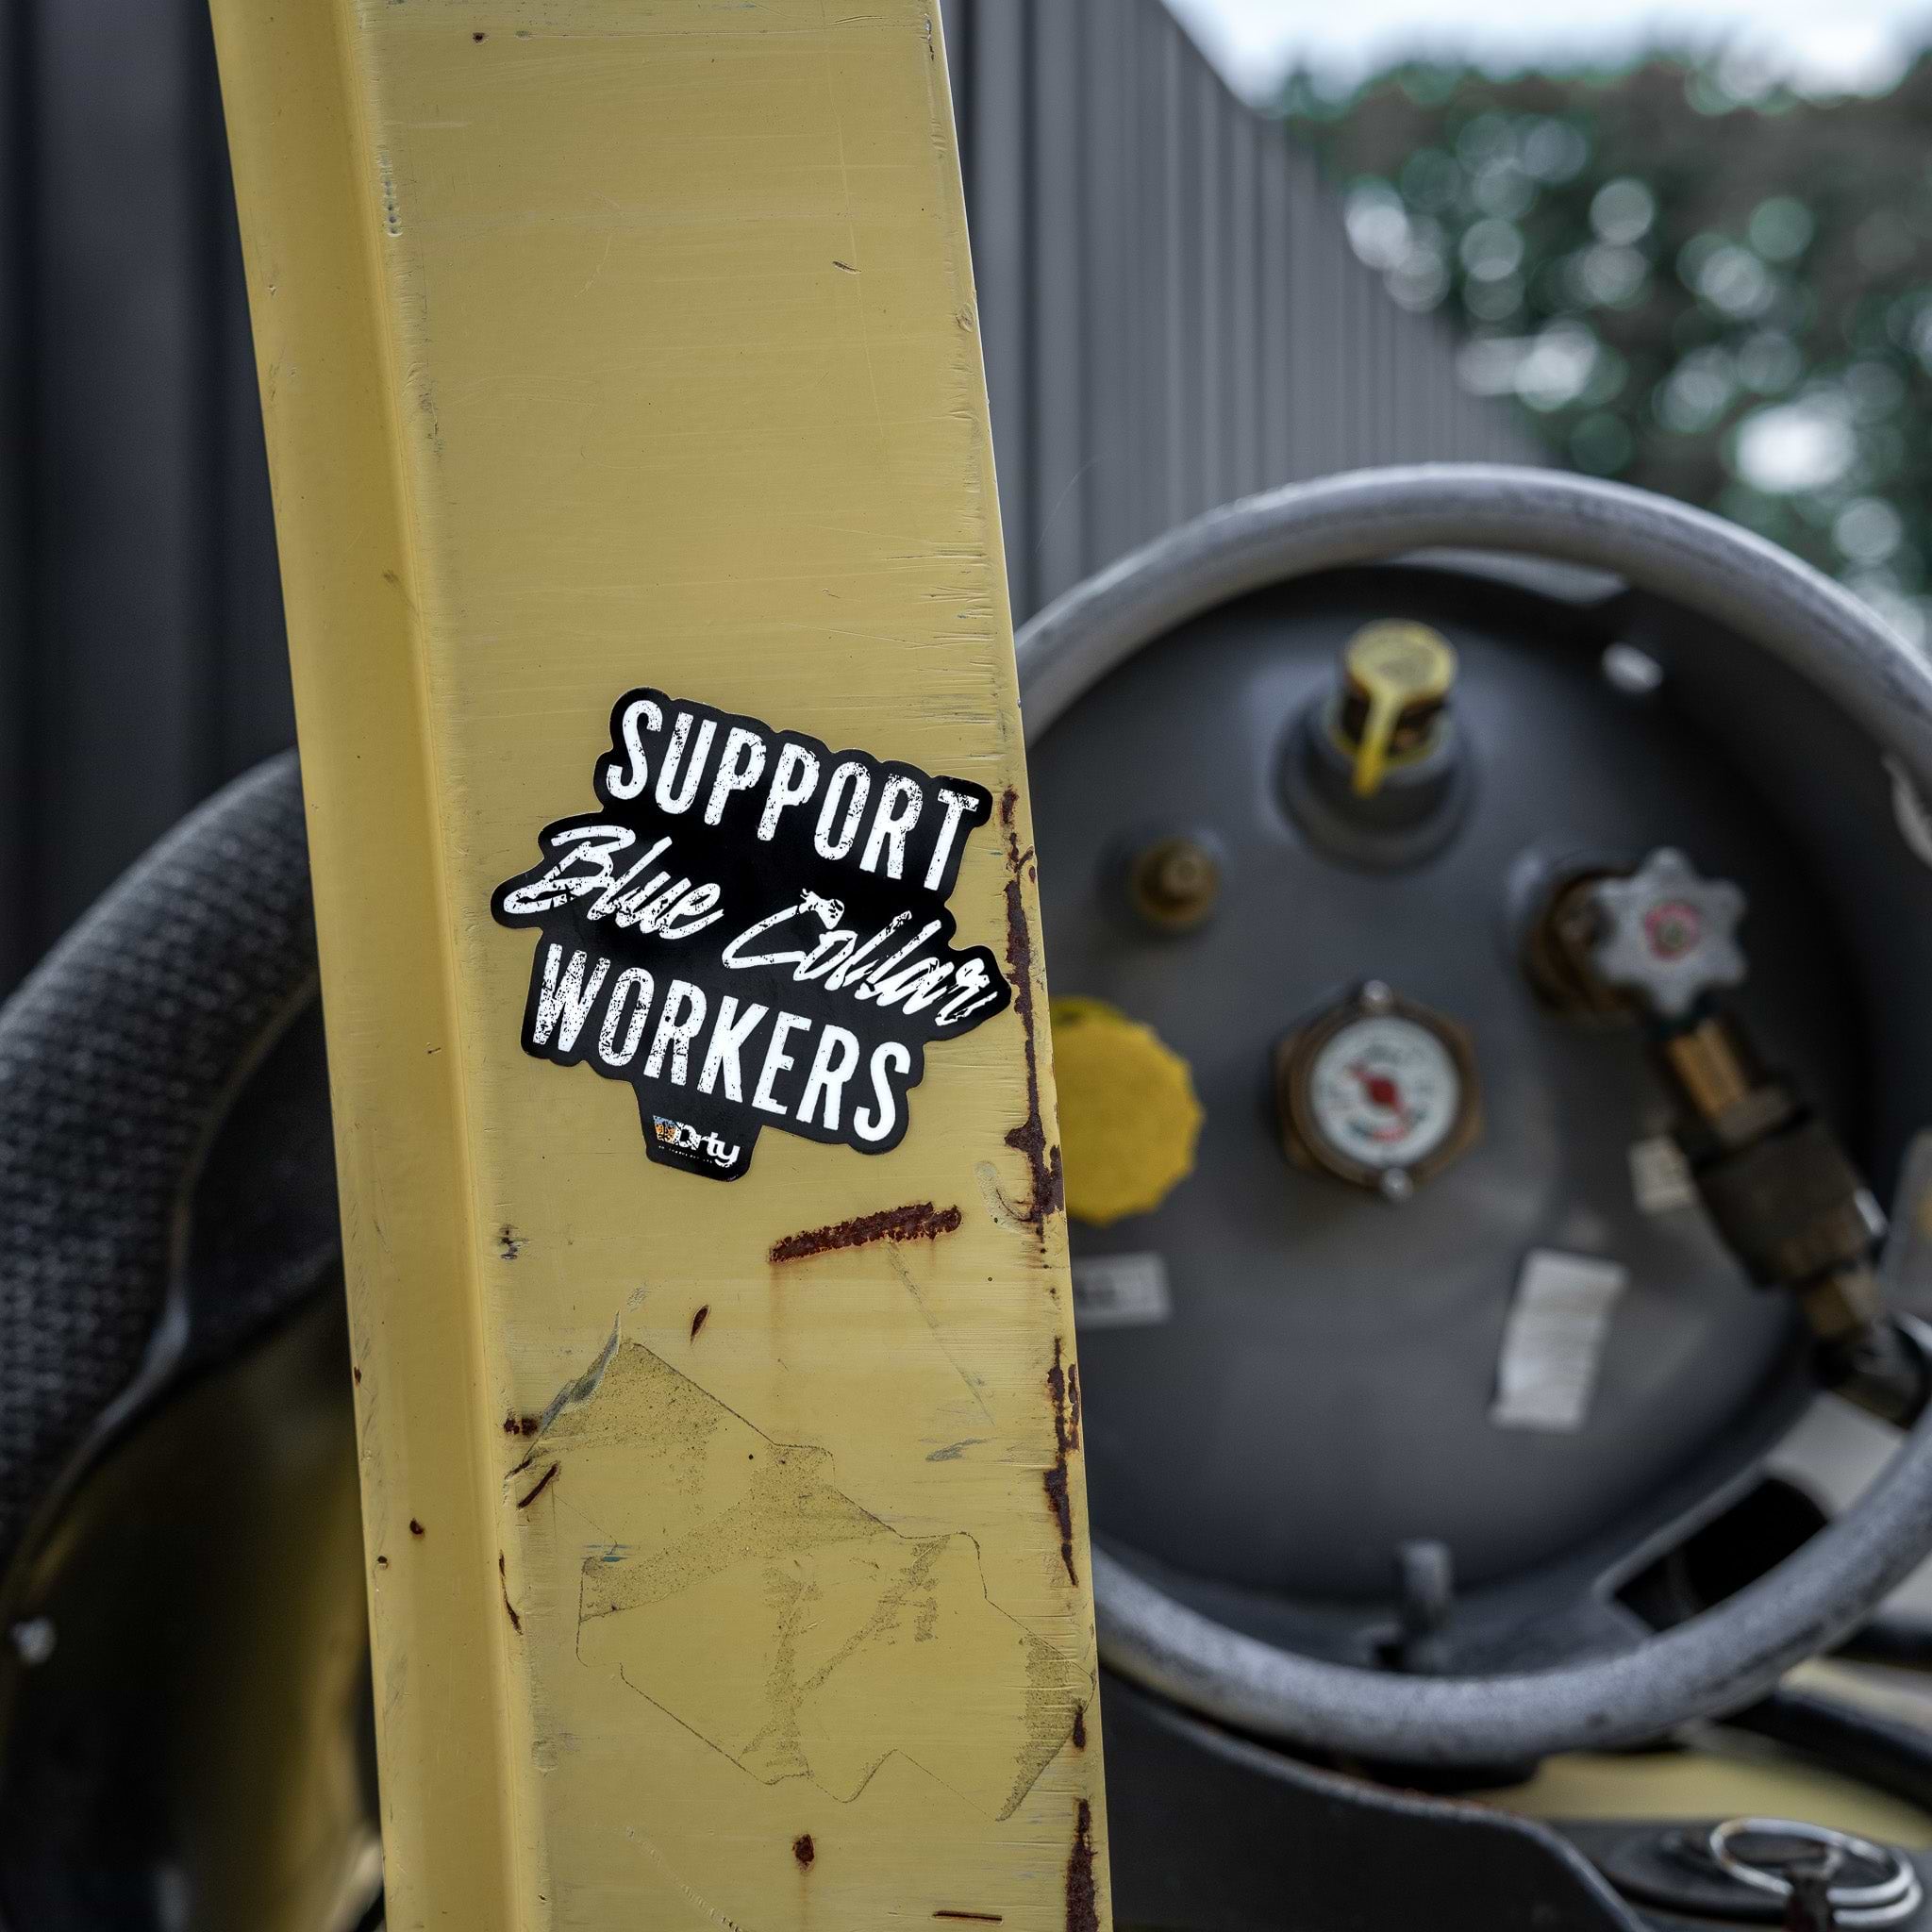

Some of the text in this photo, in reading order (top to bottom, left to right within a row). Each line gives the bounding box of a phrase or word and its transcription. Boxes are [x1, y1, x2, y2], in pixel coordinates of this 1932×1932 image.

[606, 700, 979, 890] SUPPORT
[503, 824, 997, 1026] Blue Collar
[532, 943, 909, 1141] WORKERS
